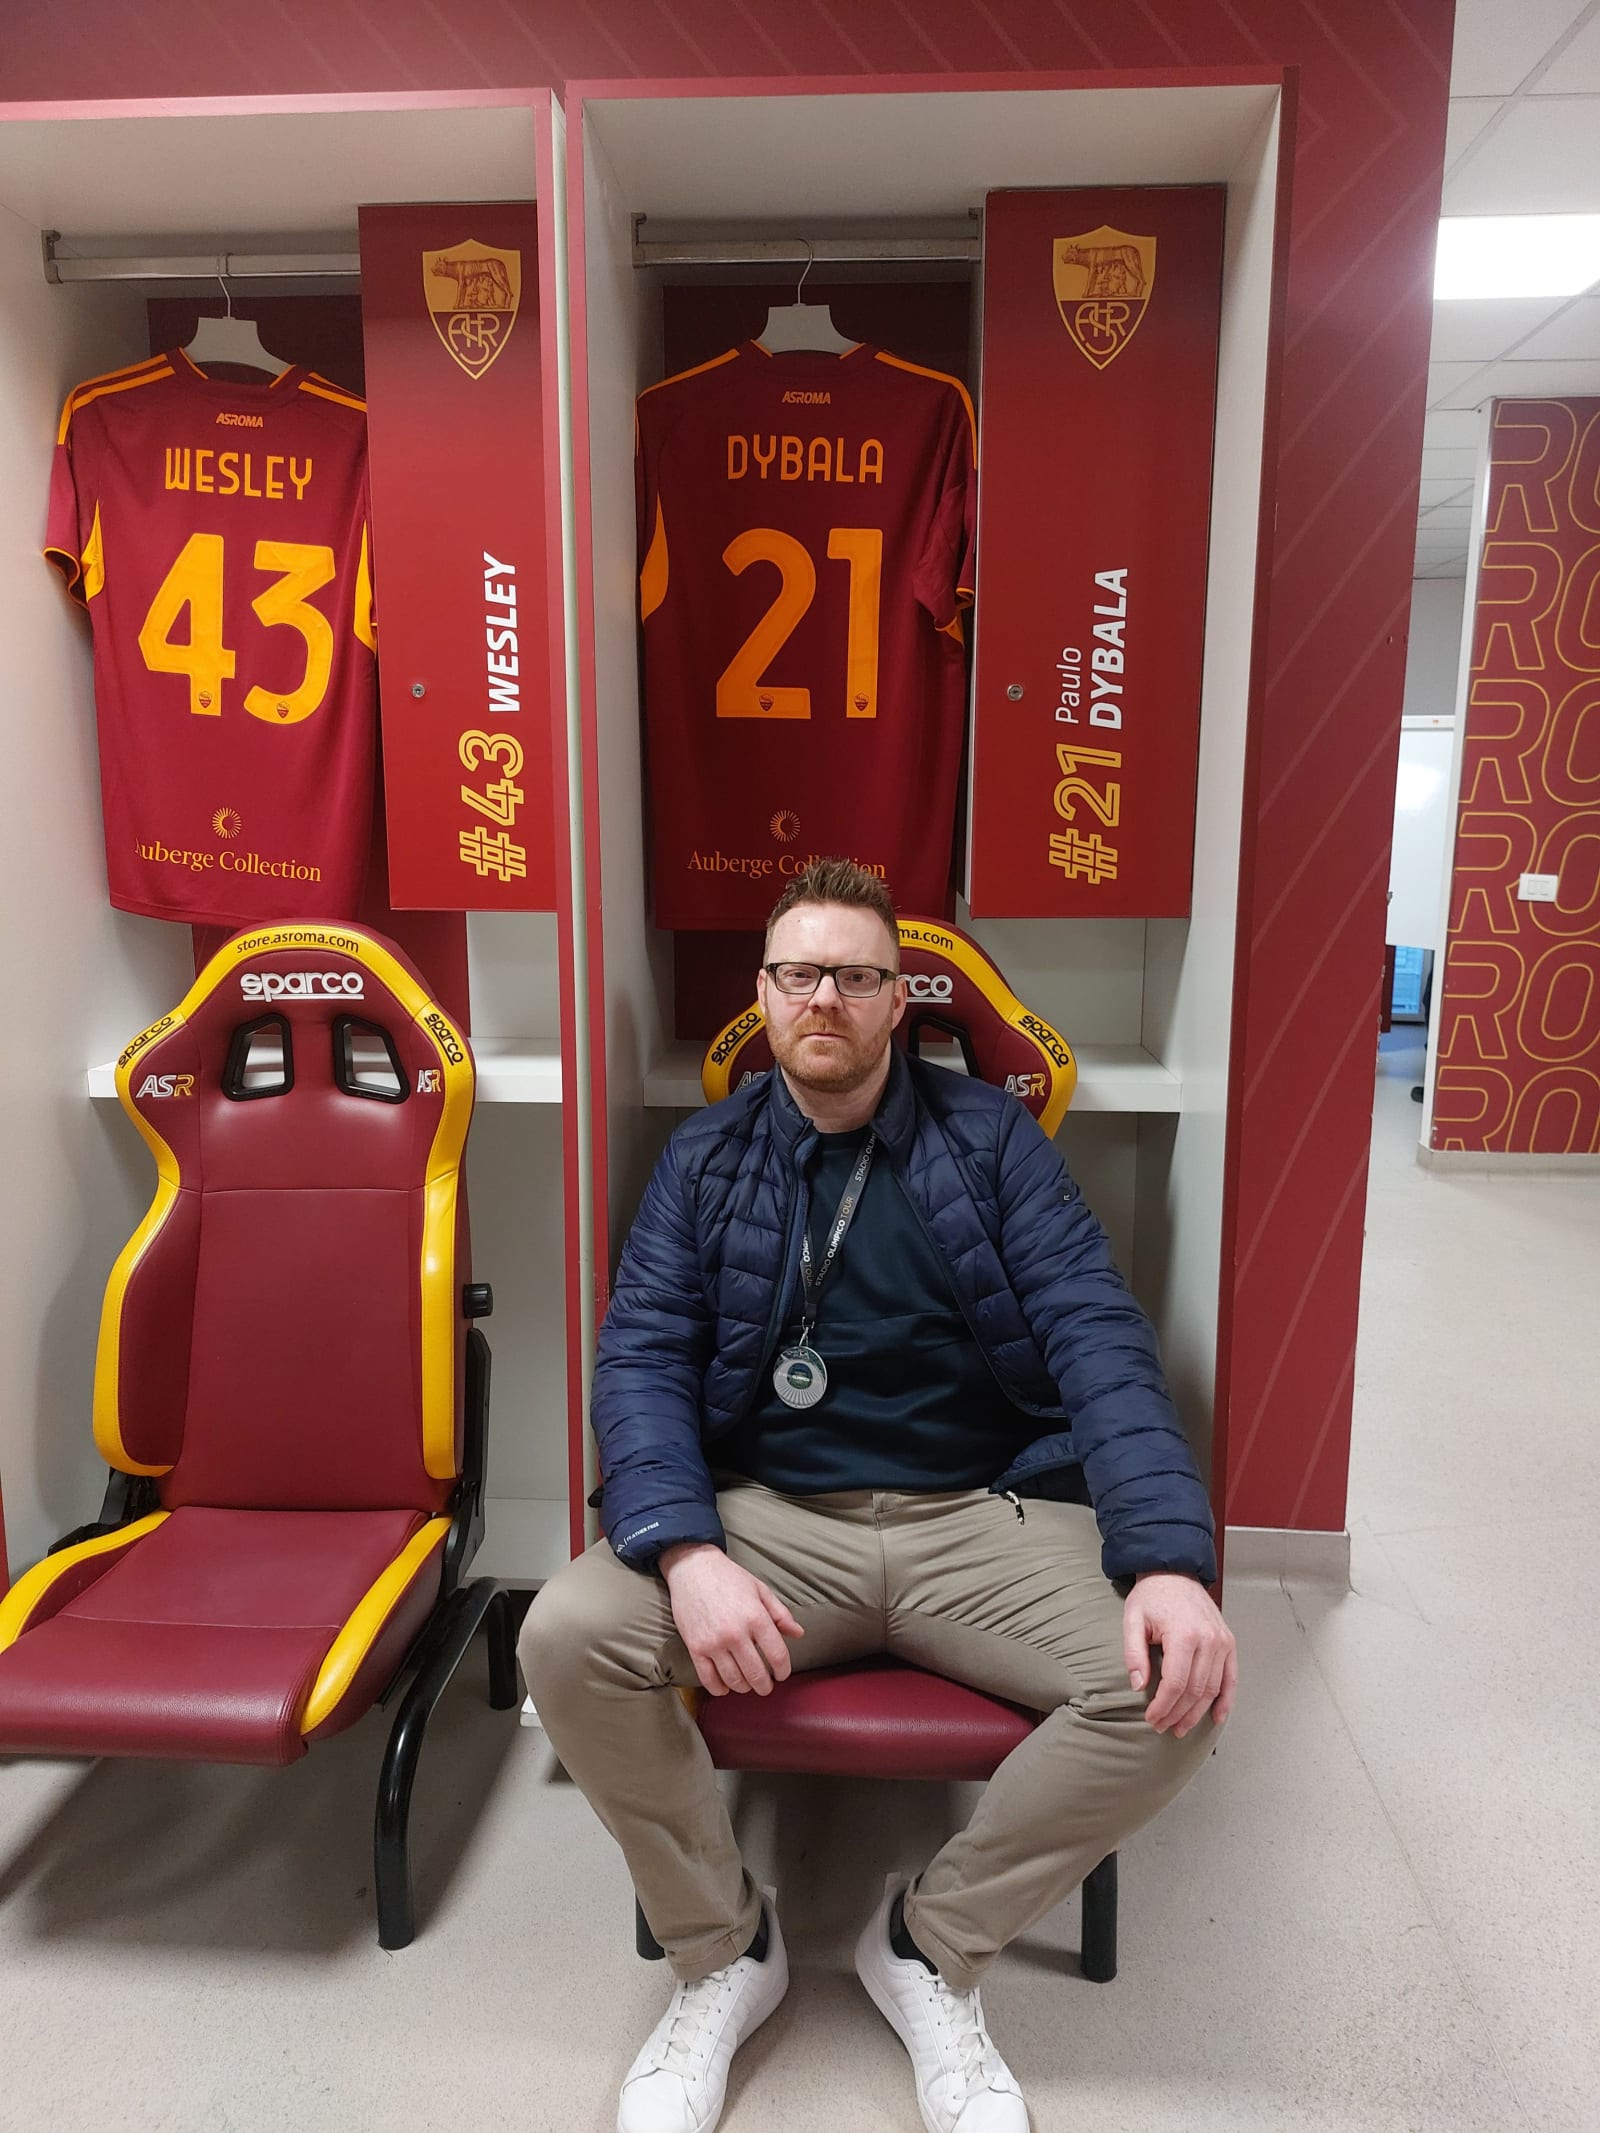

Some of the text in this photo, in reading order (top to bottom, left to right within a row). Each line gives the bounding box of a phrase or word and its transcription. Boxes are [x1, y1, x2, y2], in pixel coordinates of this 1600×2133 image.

[164, 448, 313, 500] WESLEY
[727, 434, 884, 484] DYBALA
[138, 532, 336, 725] 43
[716, 528, 883, 719] 21
[1089, 568, 1128, 730] DYBALA
[1055, 647, 1082, 724] Paulo
[459, 550, 527, 882] #43 WESLEY
[1049, 743, 1122, 885] #21
[219, 851, 321, 882] Collection
[687, 850, 773, 879] Auberge
[237, 931, 360, 953] store.asroma.com
[240, 971, 365, 1002] sparco
[117, 1016, 174, 1069] sparco
[424, 1012, 464, 1066] sparco
[711, 1012, 761, 1066] sparco
[1018, 1015, 1069, 1068] sparco
[135, 1073, 195, 1100] ASR
[416, 1069, 442, 1094] ASR
[1004, 1073, 1046, 1097] ASR
[854, 1154, 870, 1182] STADIO
[827, 1219, 846, 1259] OLIMPICO
[842, 1196, 854, 1219] TOUR
